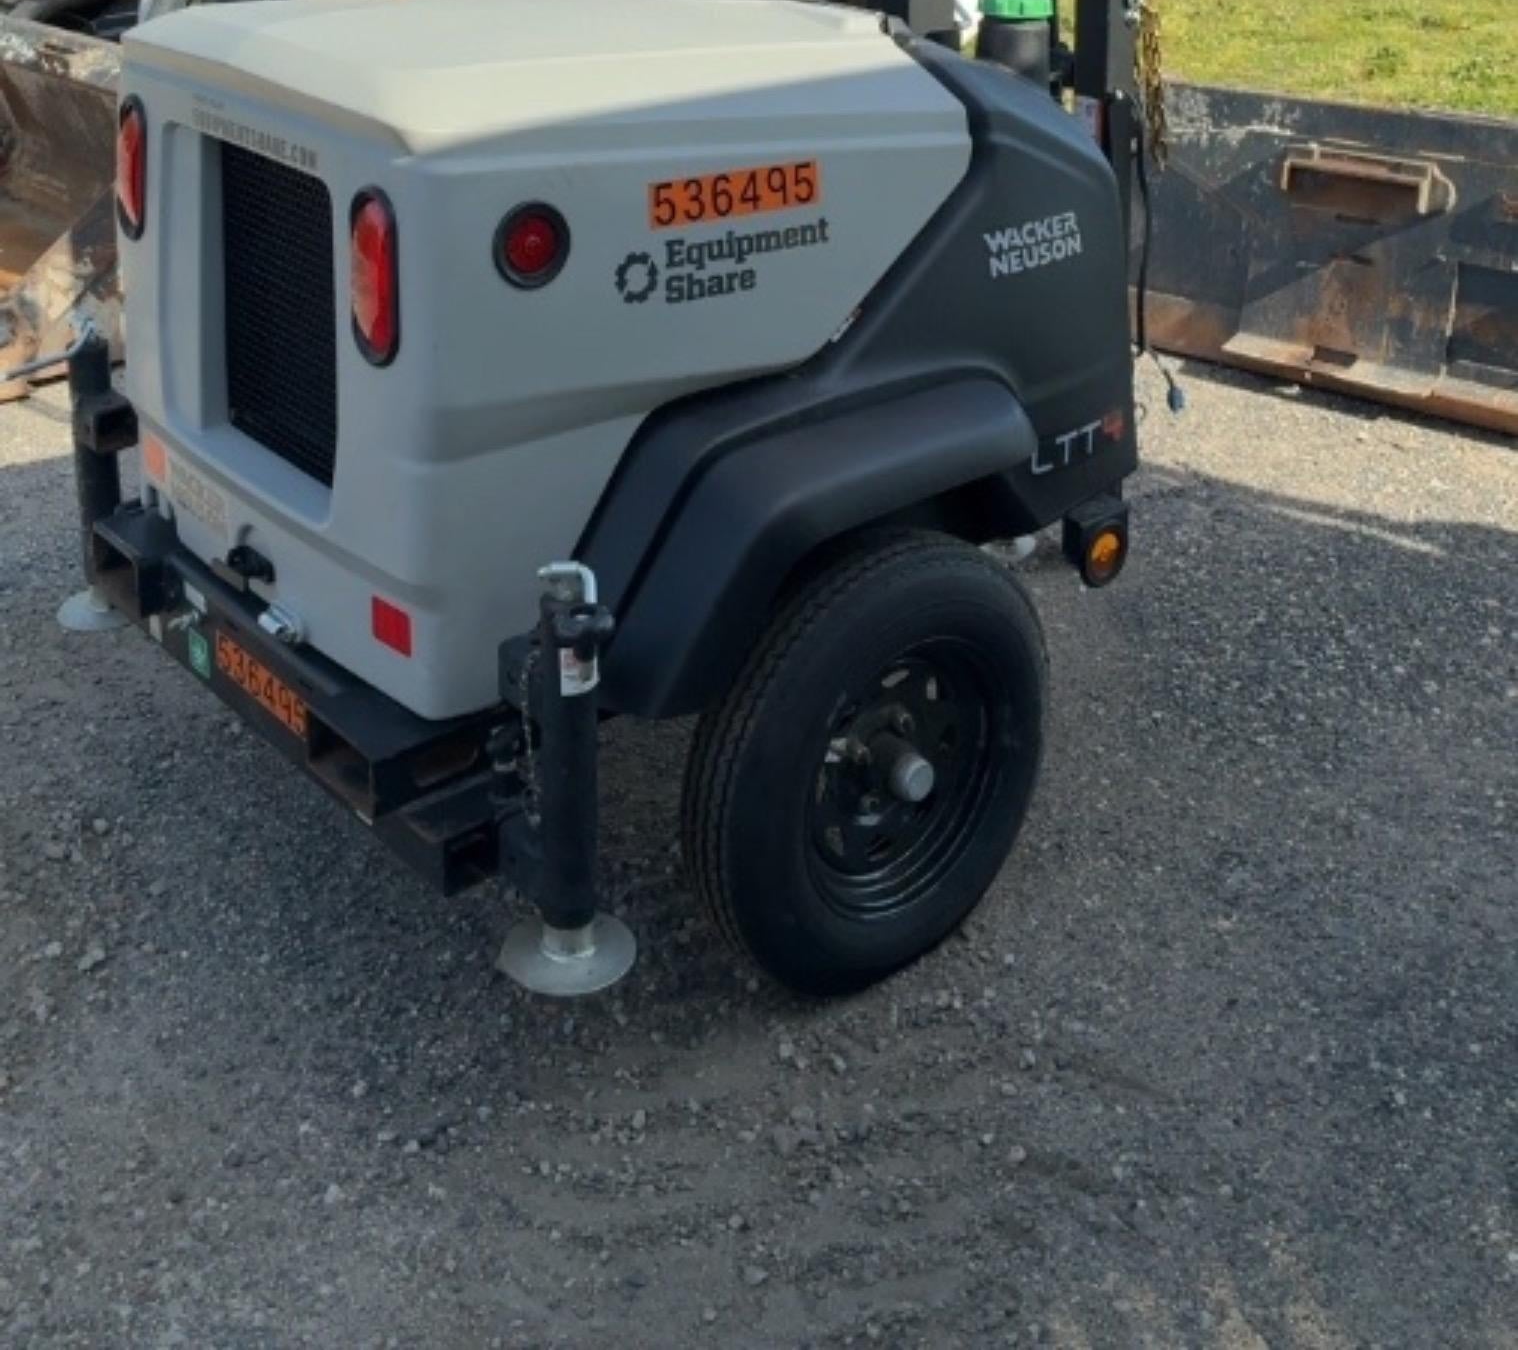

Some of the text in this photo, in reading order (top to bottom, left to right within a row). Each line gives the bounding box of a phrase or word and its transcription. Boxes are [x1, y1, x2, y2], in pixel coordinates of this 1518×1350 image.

[653, 161, 815, 226] 536495
[664, 217, 829, 271] Equipment
[983, 212, 1078, 253] WACKER
[989, 233, 1083, 278] NEUSON
[664, 267, 757, 303] Share
[217, 633, 305, 735] 536495
